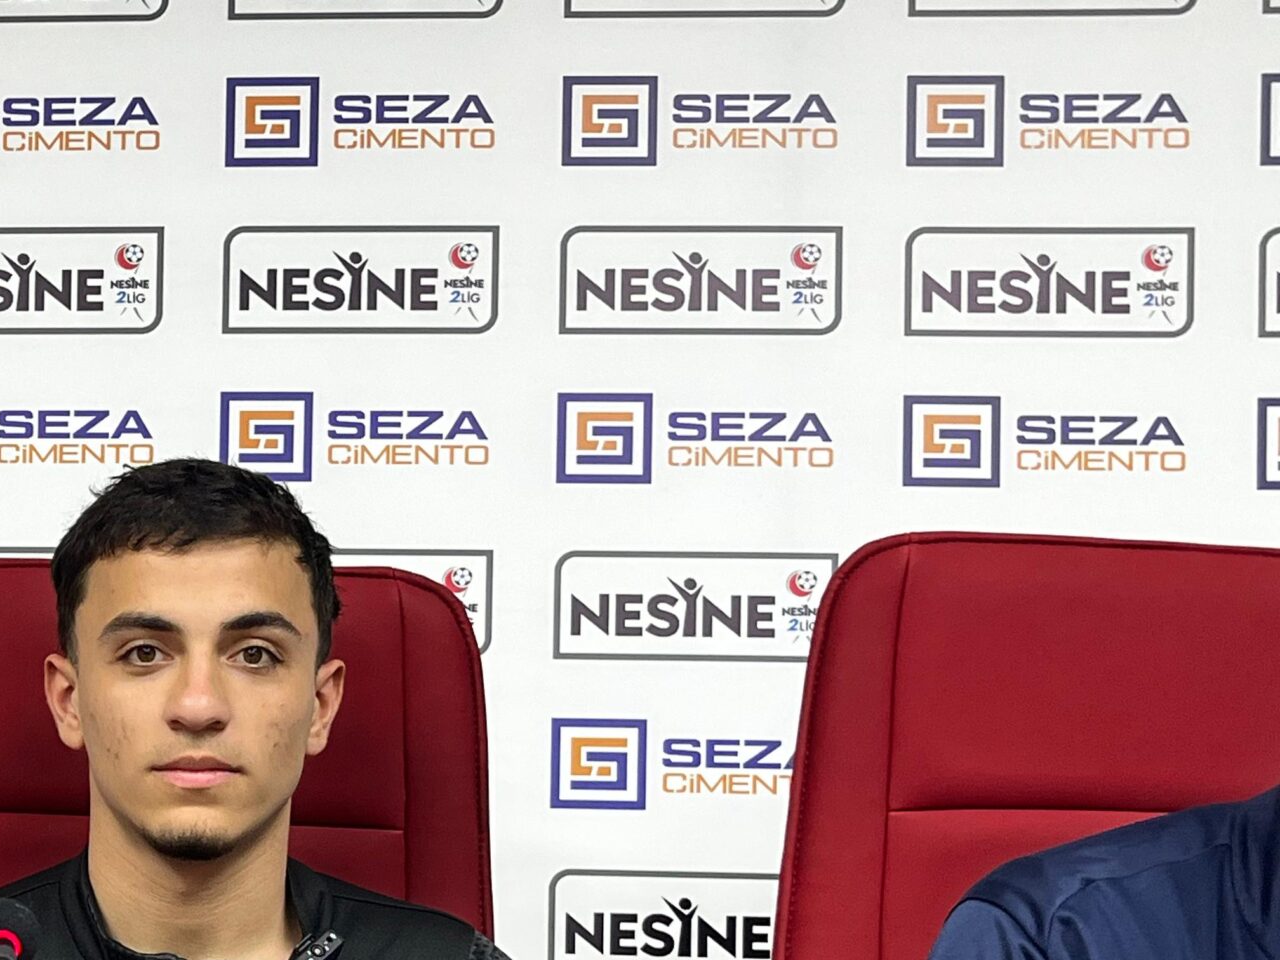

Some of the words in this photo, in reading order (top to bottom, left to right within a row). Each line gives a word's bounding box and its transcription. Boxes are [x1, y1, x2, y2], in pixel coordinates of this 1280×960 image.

[3, 97, 158, 126] SEZA
[334, 95, 492, 124] SEZA
[673, 94, 832, 123] SEZA
[1022, 94, 1184, 123] SEZA
[328, 411, 488, 440] SEZA
[668, 412, 832, 442] SEZA
[1017, 416, 1183, 445] SEZA
